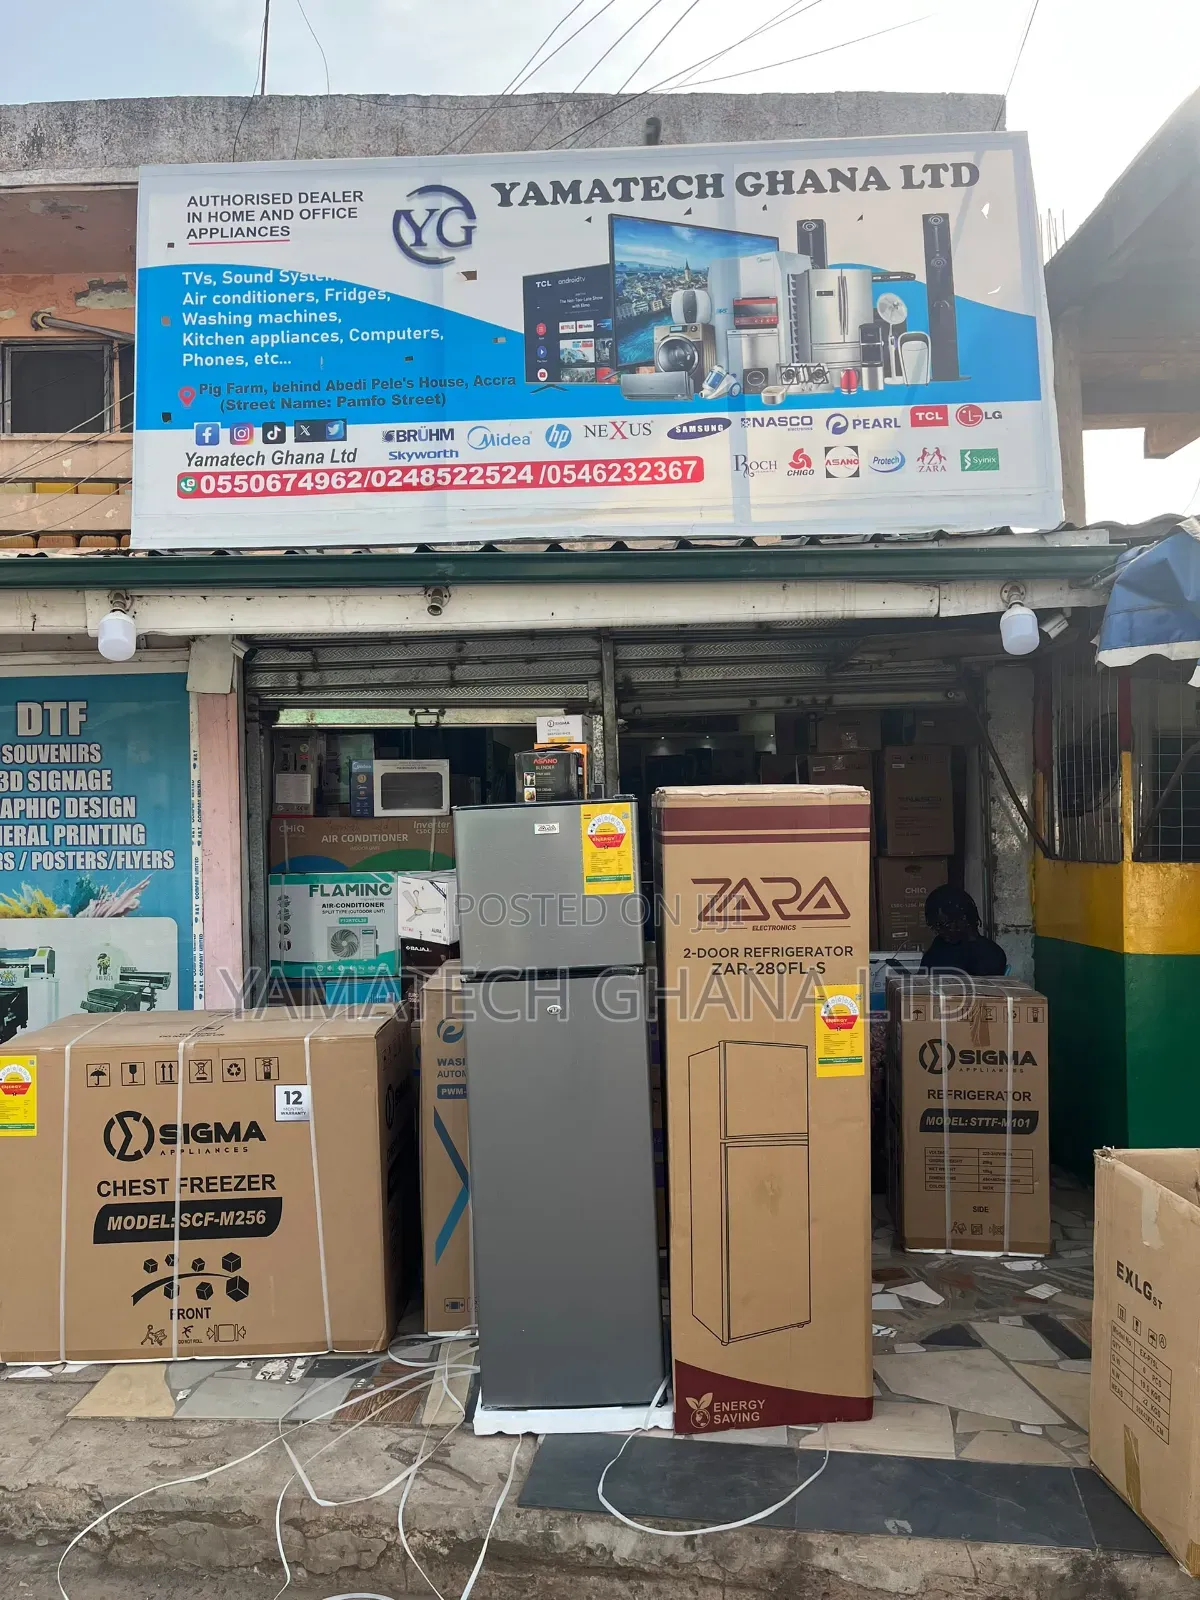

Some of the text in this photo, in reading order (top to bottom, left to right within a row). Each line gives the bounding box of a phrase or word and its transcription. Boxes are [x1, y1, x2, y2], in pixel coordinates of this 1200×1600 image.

[491, 162, 980, 207] YAMATECH GHANA LTD
[187, 190, 364, 207] AUTHORISED DEALER
[187, 207, 358, 223] IN HOME AND OFFICE
[186, 226, 290, 240] APPLIANCES
[182, 272, 217, 286] TVs,
[222, 270, 273, 284] Sound
[182, 287, 391, 305] Air conditioners, Fridges,
[182, 311, 342, 327] Washing machines,
[182, 327, 444, 347] Kitchen appliances, Computers,
[182, 351, 292, 367] Phones, etc...
[199, 375, 516, 397] Pig Farm, behind Abedi Pele's House, Accra
[220, 392, 446, 414] (Street Name: Pamfo Street)
[752, 415, 813, 428] NASCO
[853, 417, 901, 430] PEARL
[915, 411, 943, 420] TCL
[985, 411, 1002, 420] LG
[395, 426, 455, 443] BRÜHM
[583, 420, 653, 440] NEXUS
[675, 424, 724, 433] SAMSUNG
[472, 429, 531, 449] Midea
[548, 427, 568, 449] hp
[185, 448, 358, 467] Yamatech Ghana Ltd
[388, 449, 459, 463] Skyworth
[872, 456, 900, 465] Protech
[787, 469, 815, 477] CHIGO
[918, 465, 947, 473] ZARA
[17, 701, 87, 736] DTF
[1, 743, 102, 764] SOUVENIRS
[27, 769, 112, 792] SIGNAGE
[65, 796, 136, 818] DESIGN
[413, 821, 450, 829] Inveter
[54, 824, 146, 846] PRINTING
[321, 833, 408, 843] AIR CONDITIONER
[31, 850, 175, 870] POSTERS/FLYERS
[690, 875, 851, 921] ZARA
[751, 924, 797, 932] ELECTRONICS
[683, 945, 853, 959] 2-DOOR REFRIGERATOR
[711, 961, 826, 976] ZAR-280FL-S
[958, 1050, 1038, 1066] SIGMA
[284, 1091, 303, 1105] 12
[925, 1116, 968, 1127] MODEL:
[159, 1121, 267, 1145] SIGMA
[160, 1146, 248, 1156] APPLIANCES
[96, 1174, 277, 1197] CHEST FREEZER
[107, 1209, 267, 1231] MODEL: SCF-M256
[1152, 1374, 1162, 1388] PCS
[1151, 1389, 1161, 1403] KGS
[713, 1399, 766, 1413] ENERGY
[1150, 1403, 1161, 1418] KGS
[713, 1411, 760, 1424] SAVING
